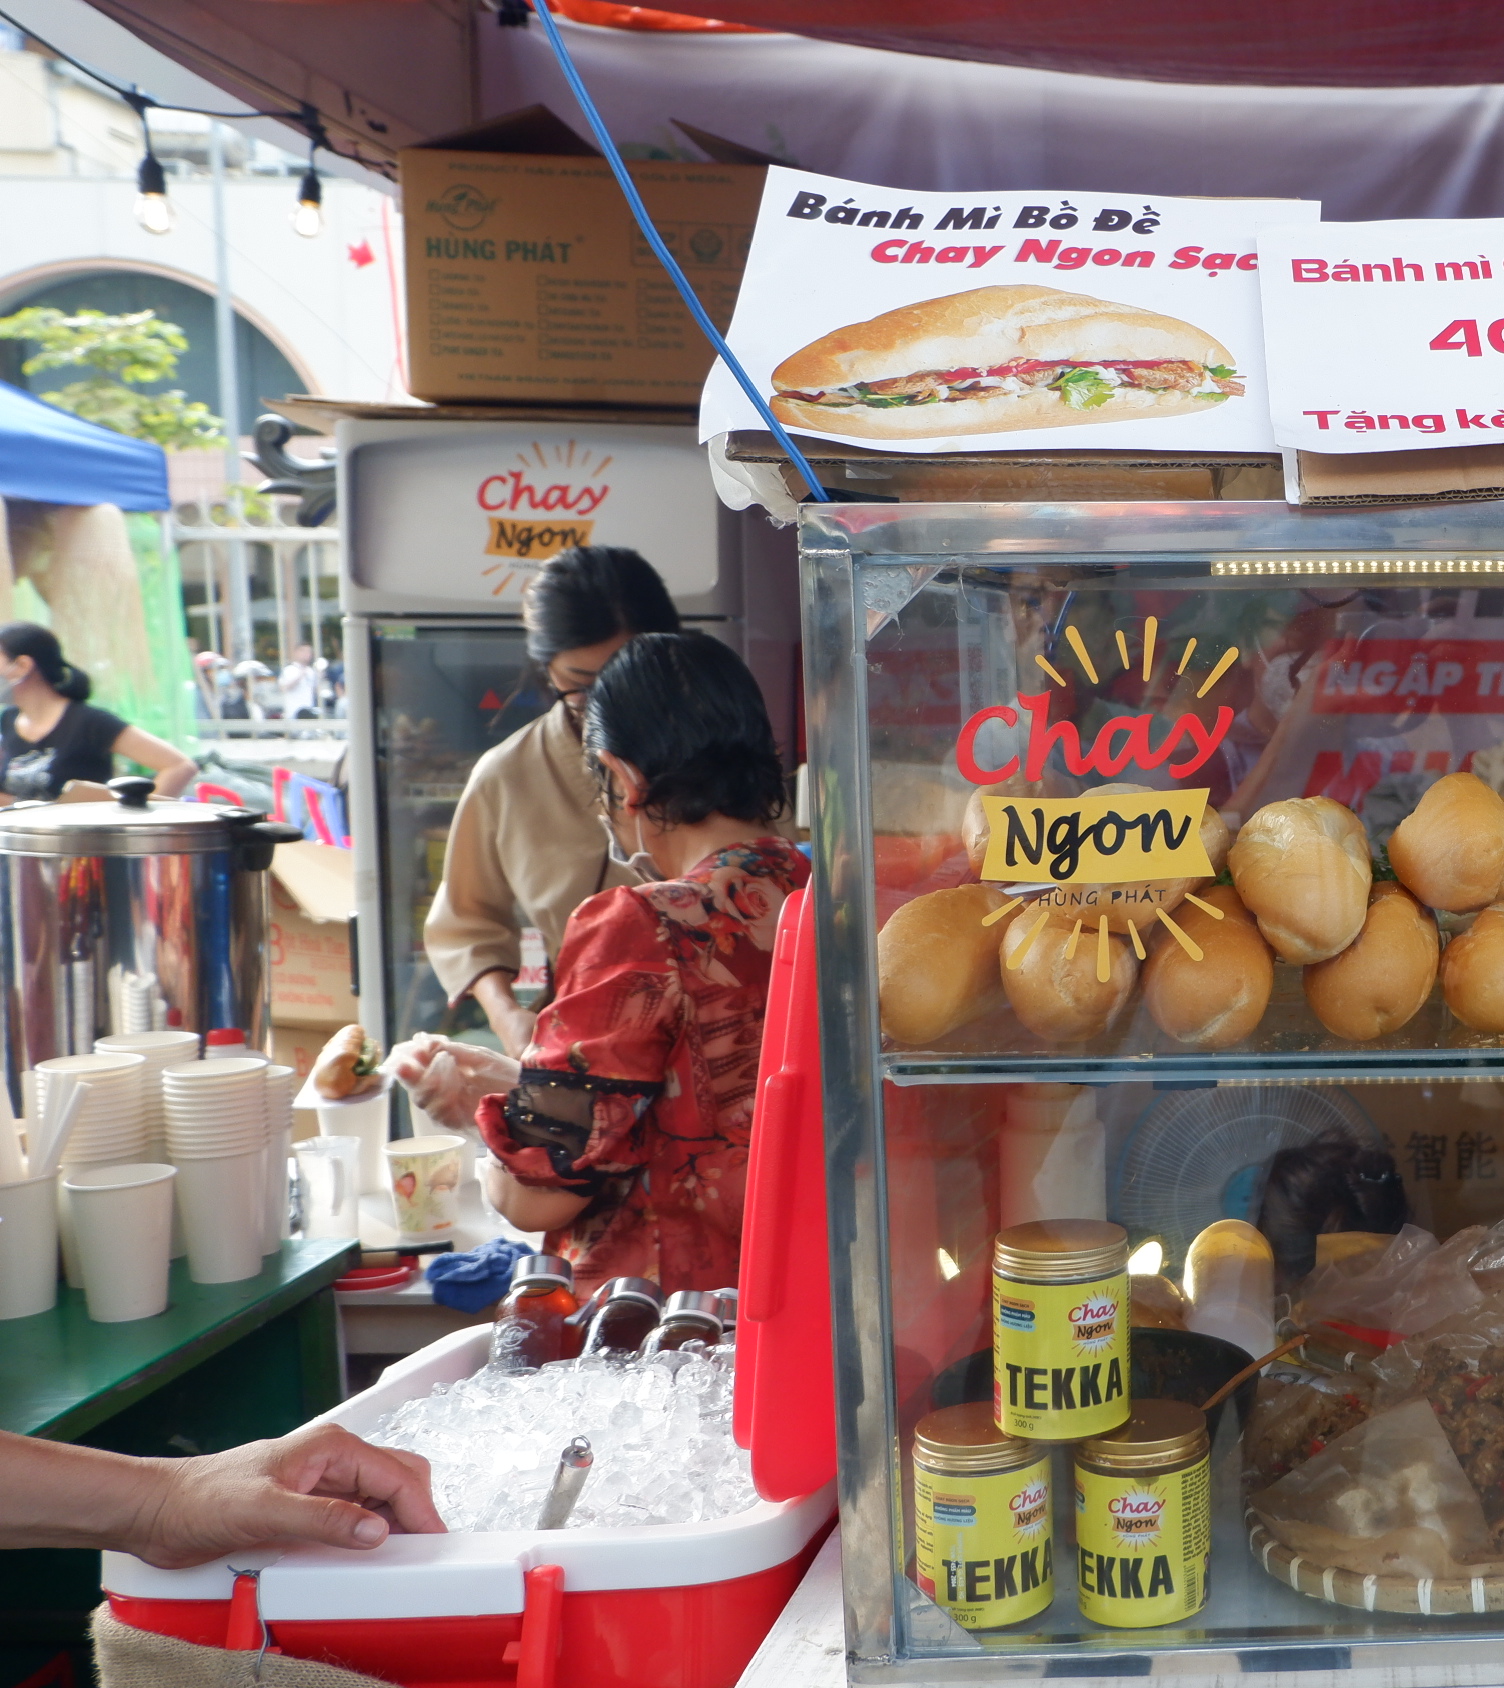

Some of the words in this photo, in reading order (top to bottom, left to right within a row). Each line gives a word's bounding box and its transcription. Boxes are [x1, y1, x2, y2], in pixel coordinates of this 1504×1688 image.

[786, 190, 924, 230] Bánh
[933, 204, 1004, 231] Mì
[1012, 200, 1078, 231] Bồ
[1092, 204, 1161, 235] Đề
[426, 231, 496, 261] HÙNG
[505, 236, 572, 265] PHÁT
[871, 238, 1005, 269] Chay
[1014, 238, 1156, 271] Ngon
[1168, 245, 1257, 278] Sạc
[1291, 257, 1424, 284] Bánh
[1435, 254, 1492, 281] mì
[1302, 409, 1447, 434] Tặng
[477, 470, 611, 516] Chay
[495, 521, 587, 557] Ngon
[1324, 653, 1464, 707] NGẬP
[955, 690, 1234, 786] Chay
[1001, 805, 1192, 881] Ngon
[1039, 886, 1099, 908] HÙNG
[1111, 884, 1167, 905] PHÁT
[1068, 1301, 1119, 1323] Chay
[1077, 1321, 1112, 1340] Ngon
[1006, 1357, 1123, 1411] TEKKA
[1014, 1419, 1027, 1429] 300
[1029, 1422, 1034, 1431] g
[1009, 1485, 1049, 1511] Chay
[1108, 1497, 1166, 1514] Chay
[1017, 1504, 1046, 1526] Ngon
[1117, 1517, 1156, 1532] Ngon
[942, 1537, 1053, 1602] TEKKA
[1077, 1544, 1175, 1599] EKKA
[954, 1614, 969, 1622] 300
[970, 1615, 977, 1624] g
